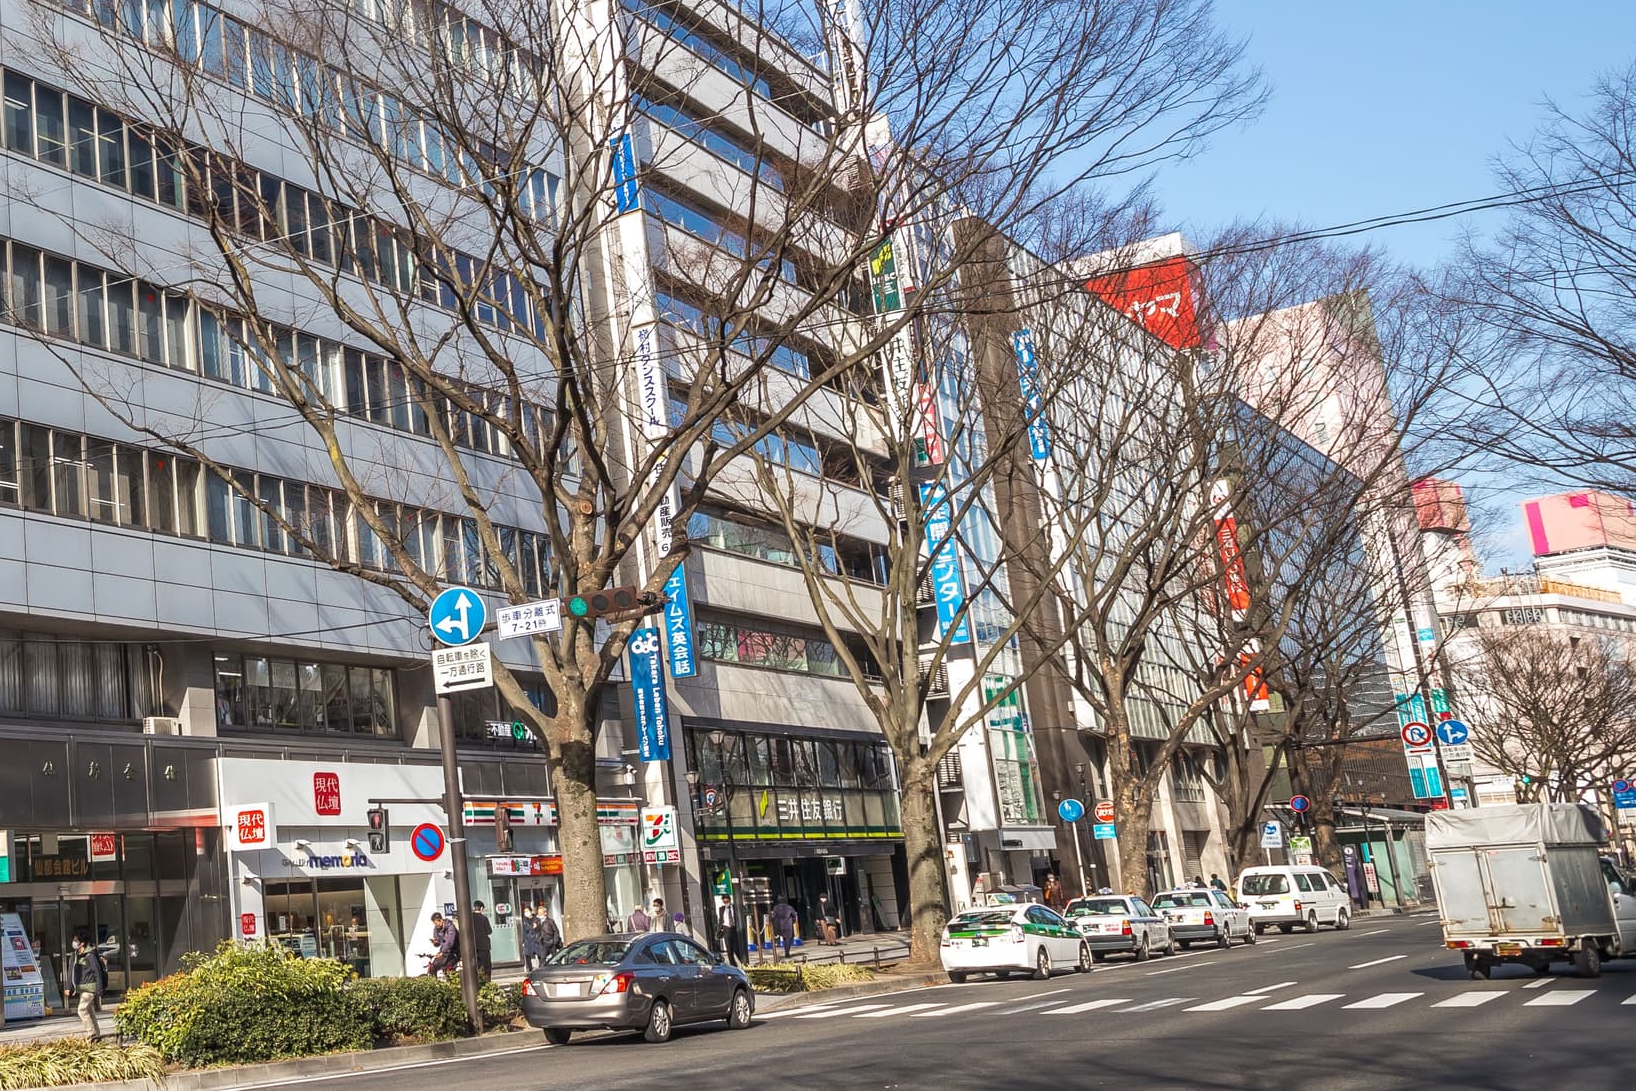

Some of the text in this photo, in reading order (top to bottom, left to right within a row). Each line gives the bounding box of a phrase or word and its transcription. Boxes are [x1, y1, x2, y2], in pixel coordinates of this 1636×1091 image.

[501, 604, 556, 624] 歩車分離式
[668, 576, 691, 675] エイムズ英会話
[437, 648, 486, 665] 自転車を除く
[440, 662, 485, 678] 一方通行路
[649, 653, 665, 747] Takara Leben Tohoku
[315, 777, 339, 793] 現代
[316, 795, 340, 810] 仏壇
[777, 798, 843, 820] 三井住友銀行
[238, 813, 264, 827] 現代
[239, 828, 264, 840] 仏壇
[35, 859, 89, 876] 仙都会館ビル
[309, 852, 368, 869] memoria
